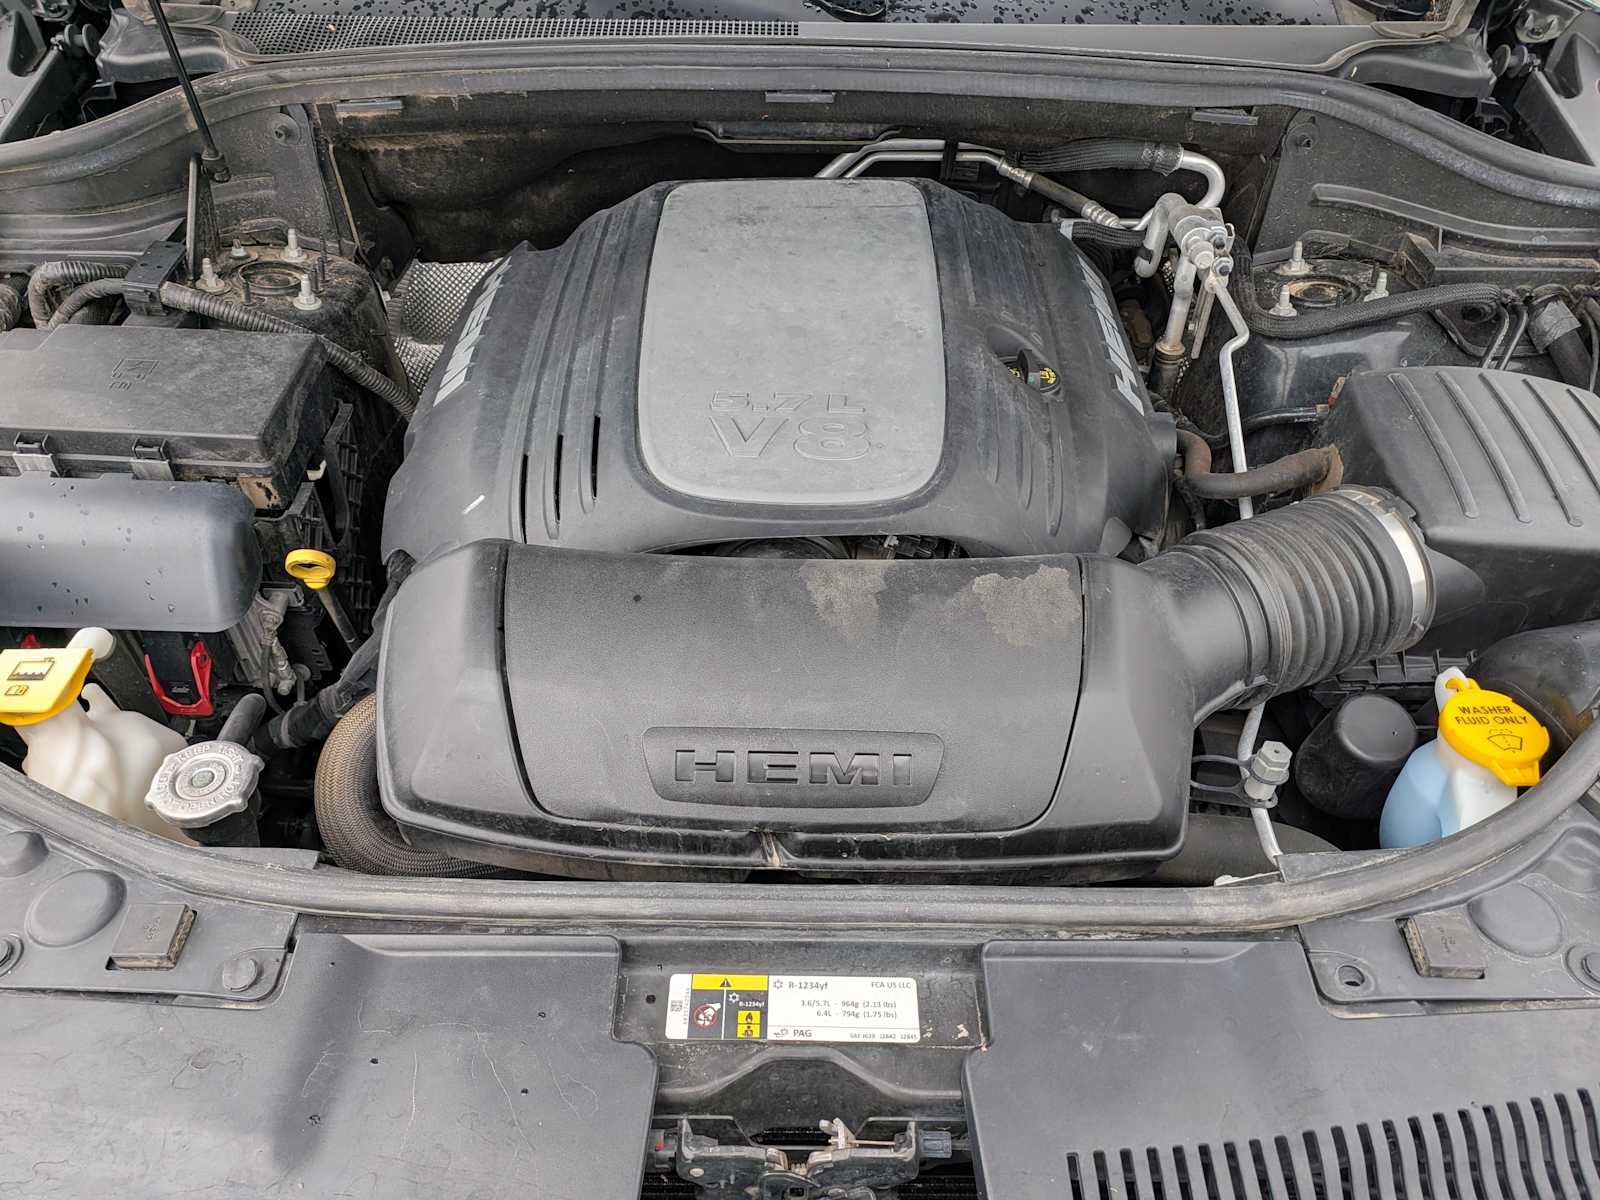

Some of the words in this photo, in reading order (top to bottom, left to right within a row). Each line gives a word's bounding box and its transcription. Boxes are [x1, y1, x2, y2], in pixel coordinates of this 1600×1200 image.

[708, 391, 867, 414] 5.7L
[707, 416, 872, 461] V8
[1458, 705, 1513, 715] WASHER
[1454, 715, 1490, 726] FLUID
[1492, 715, 1529, 725] ONLY
[674, 749, 913, 786] HEMI
[788, 981, 829, 991] R-1234yf
[871, 981, 886, 989] FCA
[886, 981, 897, 989] US
[898, 981, 912, 990] LLC
[800, 999, 831, 1008] 3.6/5.7L
[841, 1000, 860, 1009] 964g
[816, 1010, 832, 1018] 6.4L
[842, 1010, 860, 1020] 794g
[863, 1010, 882, 1020] (1.75
[882, 1011, 898, 1020] lbs)
[792, 1028, 813, 1038] PAG
